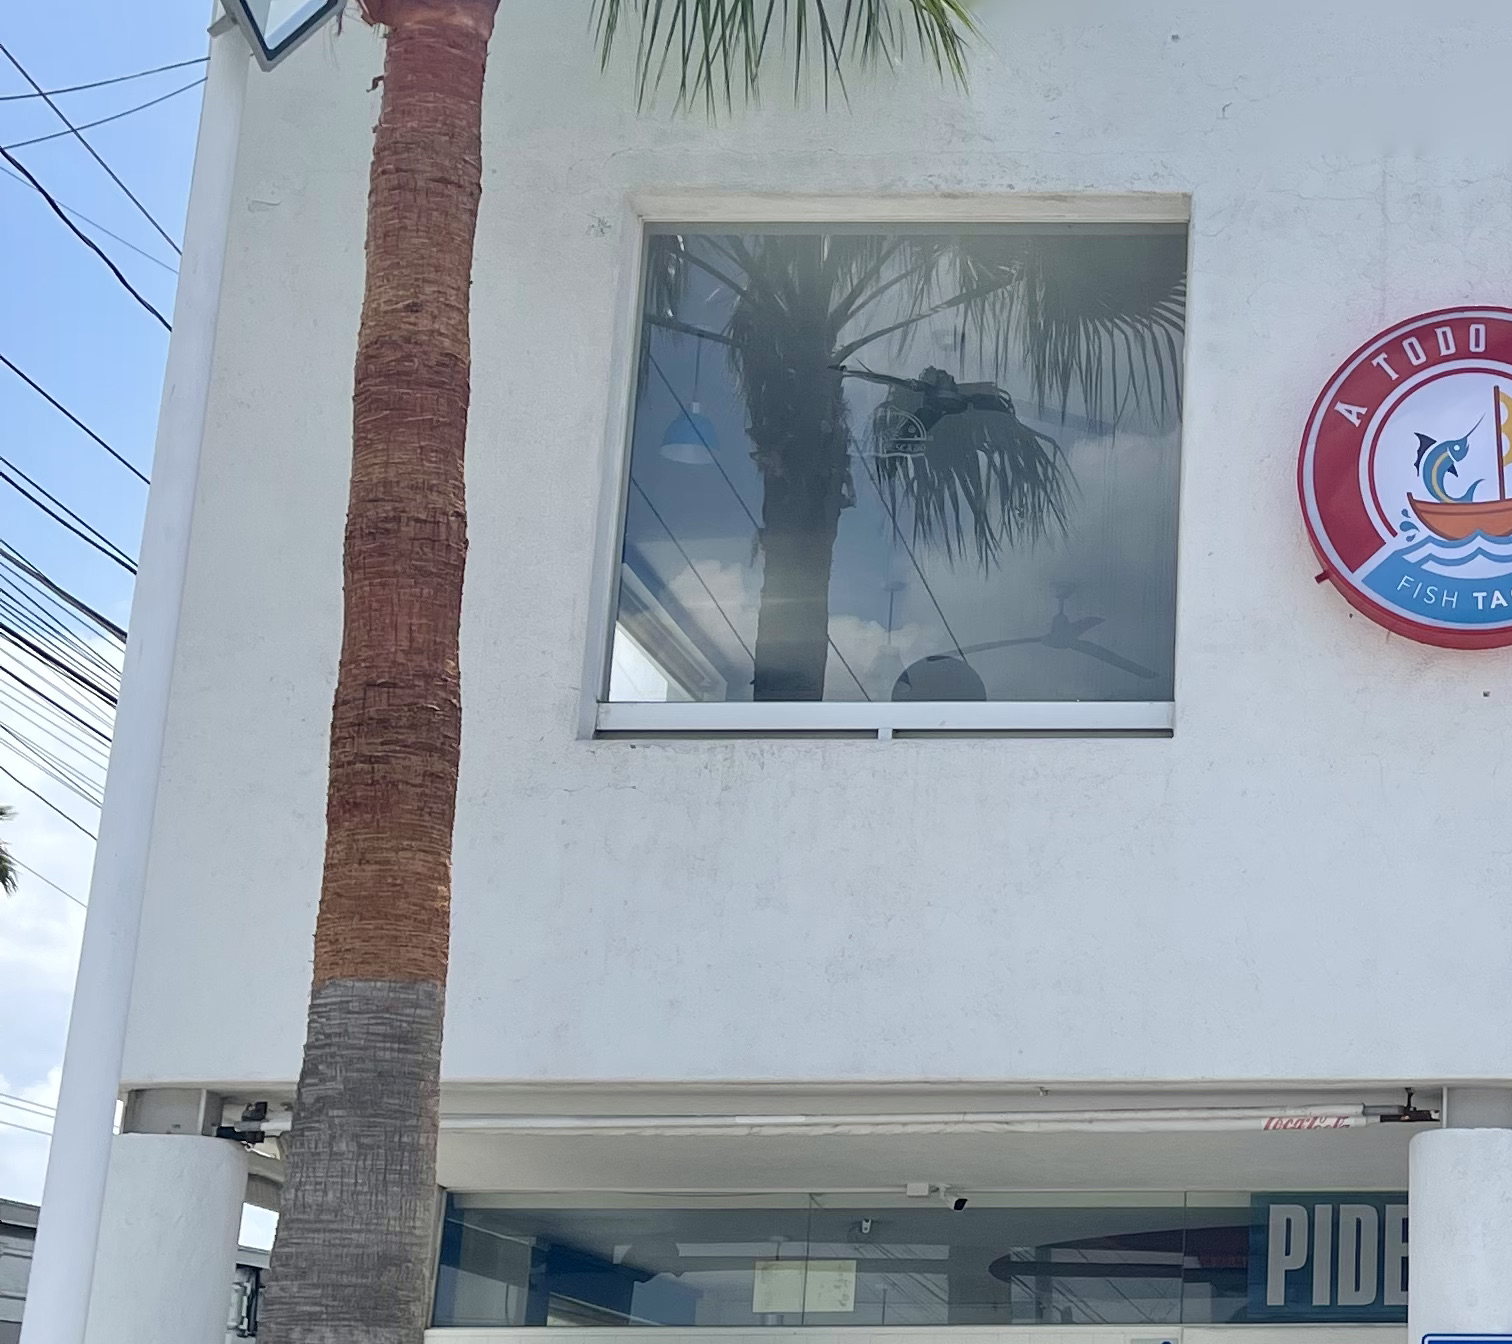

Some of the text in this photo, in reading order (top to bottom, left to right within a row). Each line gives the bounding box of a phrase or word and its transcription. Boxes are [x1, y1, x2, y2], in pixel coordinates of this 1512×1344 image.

[1334, 400, 1367, 427] A
[1372, 324, 1486, 381] TODO
[1397, 575, 1458, 609] FISH
[1267, 1204, 1408, 1306] PIDE
